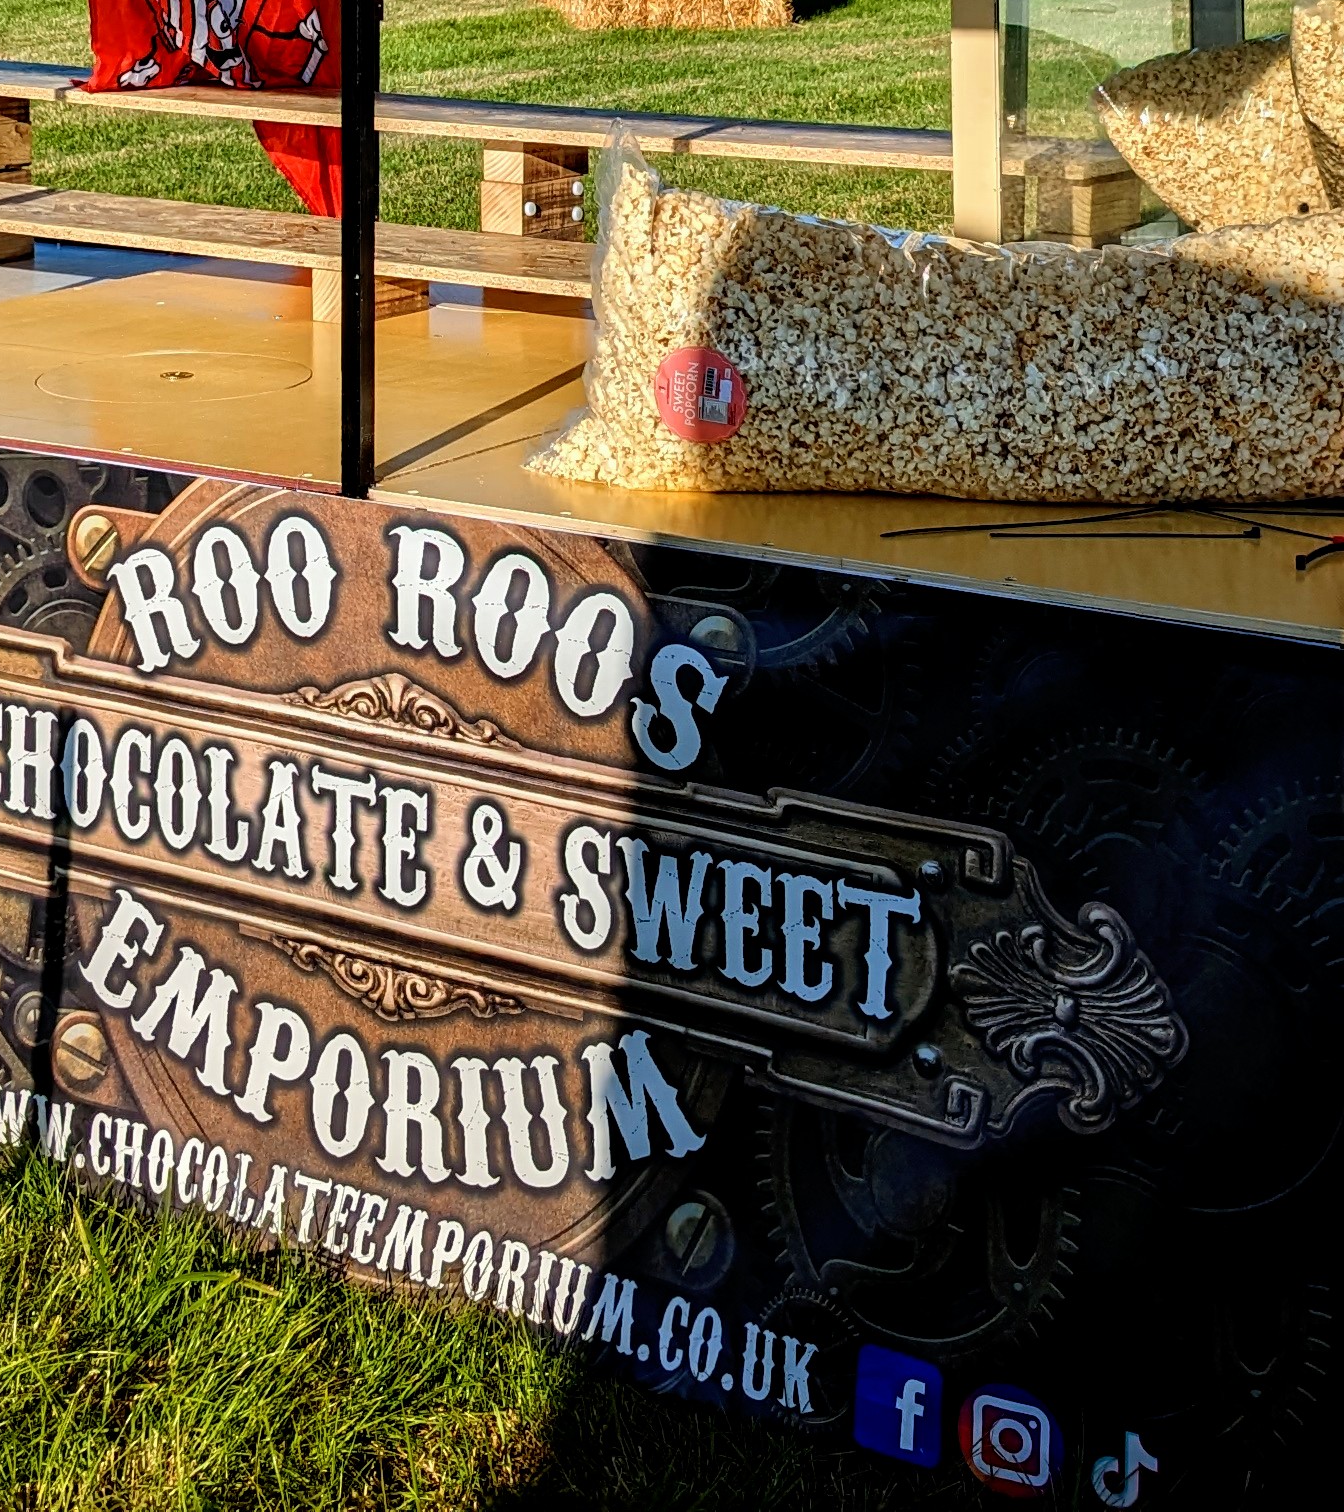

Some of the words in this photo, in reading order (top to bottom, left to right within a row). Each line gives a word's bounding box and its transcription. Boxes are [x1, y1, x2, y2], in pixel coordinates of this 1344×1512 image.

[673, 371, 686, 414] SWEET
[684, 361, 700, 428] POPCORN
[108, 513, 337, 676] ROO
[391, 525, 730, 772] ROOS
[462, 802, 524, 909] &
[561, 822, 922, 1021] SWEET
[80, 889, 707, 1192] EMPORIUM
